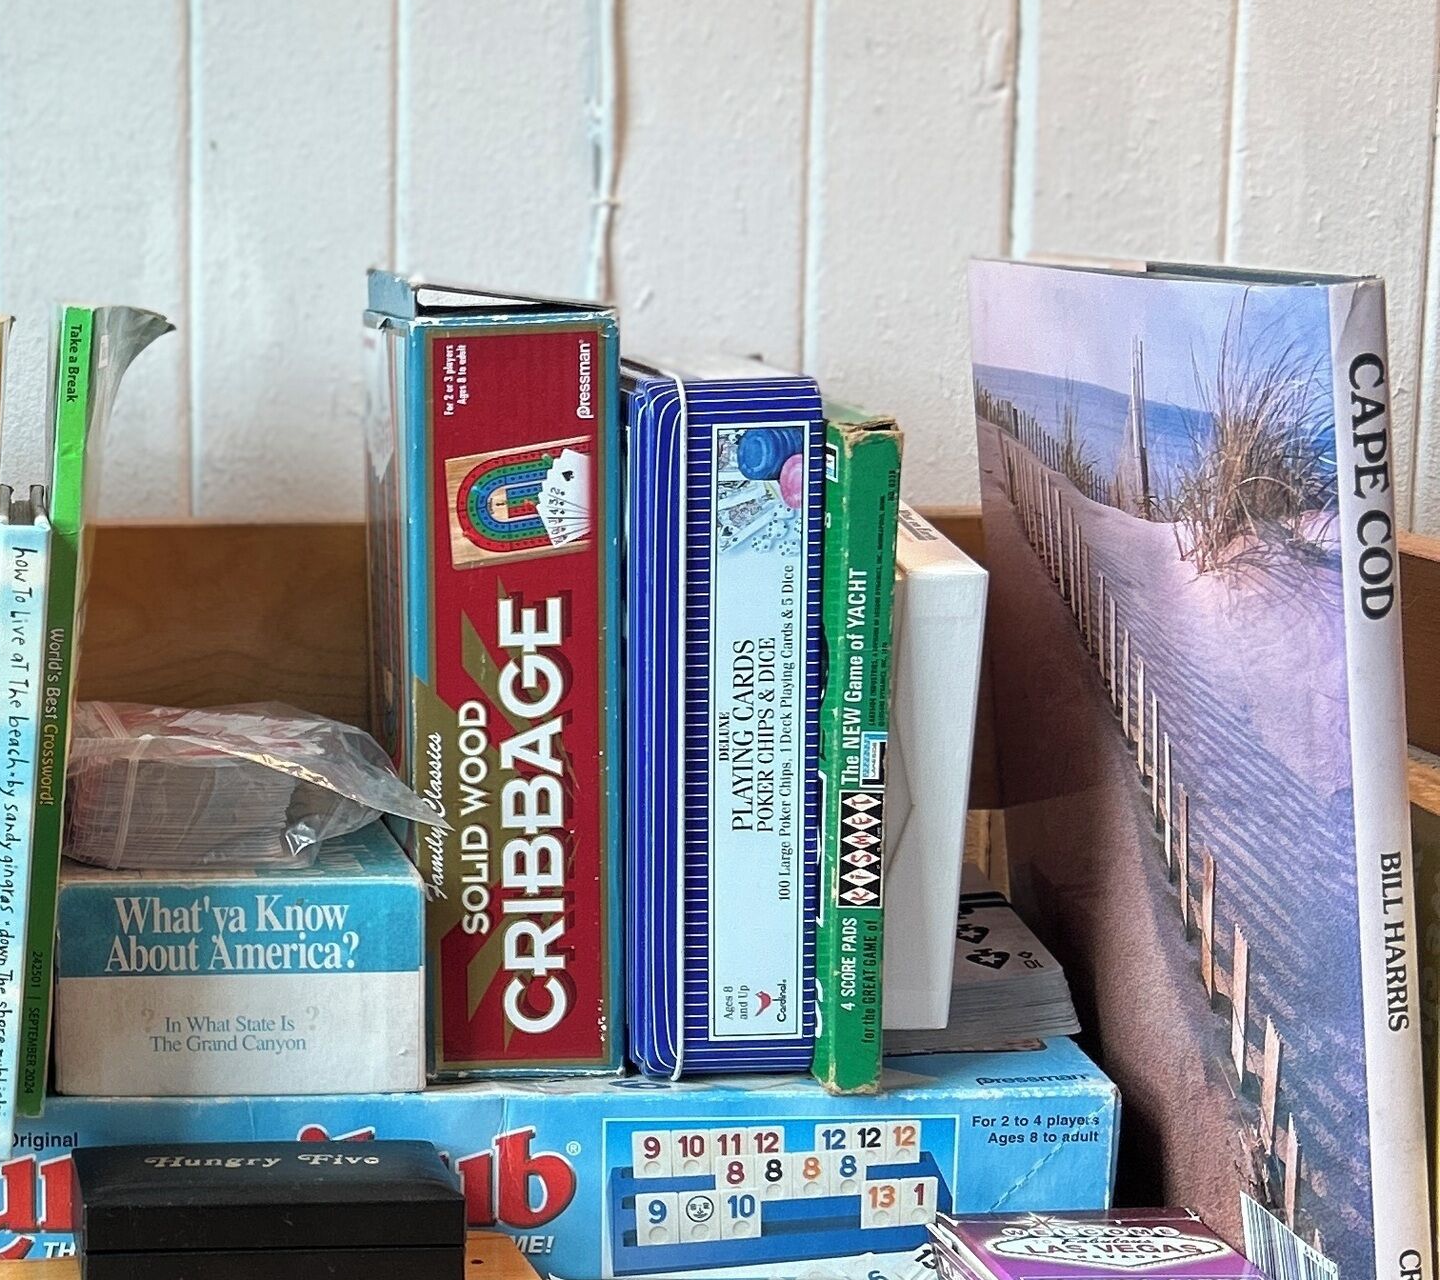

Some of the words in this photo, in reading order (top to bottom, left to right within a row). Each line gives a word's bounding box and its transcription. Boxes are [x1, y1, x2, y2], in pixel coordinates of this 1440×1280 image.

[70, 324, 82, 352] Take
[66, 366, 80, 403] Break
[576, 342, 594, 419] pressman
[1348, 352, 1391, 500] CAPE
[1356, 509, 1395, 621] COD
[847, 569, 867, 630] YACHT
[733, 638, 755, 722] CARDS
[759, 637, 775, 682] DICE
[844, 651, 864, 705] Game
[758, 688, 775, 703] &
[757, 709, 775, 764] CHIPS
[841, 706, 862, 746] NEW
[460, 699, 488, 820] WOOD
[732, 728, 755, 833] PLAYING
[497, 597, 566, 1034] CRIBBAGE
[757, 768, 773, 832] POKER
[461, 825, 490, 935] SOLID
[1380, 851, 1402, 914] BILL
[113, 896, 247, 935] What'ya
[256, 895, 349, 931] Know
[842, 917, 858, 952] PADS
[104, 935, 200, 973] About
[209, 932, 359, 971] America?
[1382, 918, 1411, 1032] HARRIS
[841, 956, 859, 999] SCORE
[165, 1017, 181, 1033] In
[186, 1017, 230, 1032] What
[236, 1016, 276, 1032] State
[281, 1015, 295, 1031] Is
[840, 1001, 857, 1013] 4
[150, 1037, 182, 1053] The
[186, 1036, 238, 1051] Grand
[242, 1036, 306, 1055] Canyon
[973, 1116, 994, 1127] For
[1000, 1116, 1008, 1126] 2
[1013, 1116, 1029, 1127] to
[1034, 1116, 1042, 1126] 4
[1047, 1114, 1100, 1129] players
[144, 1152, 282, 1171] Hungry
[298, 1152, 380, 1166] Five
